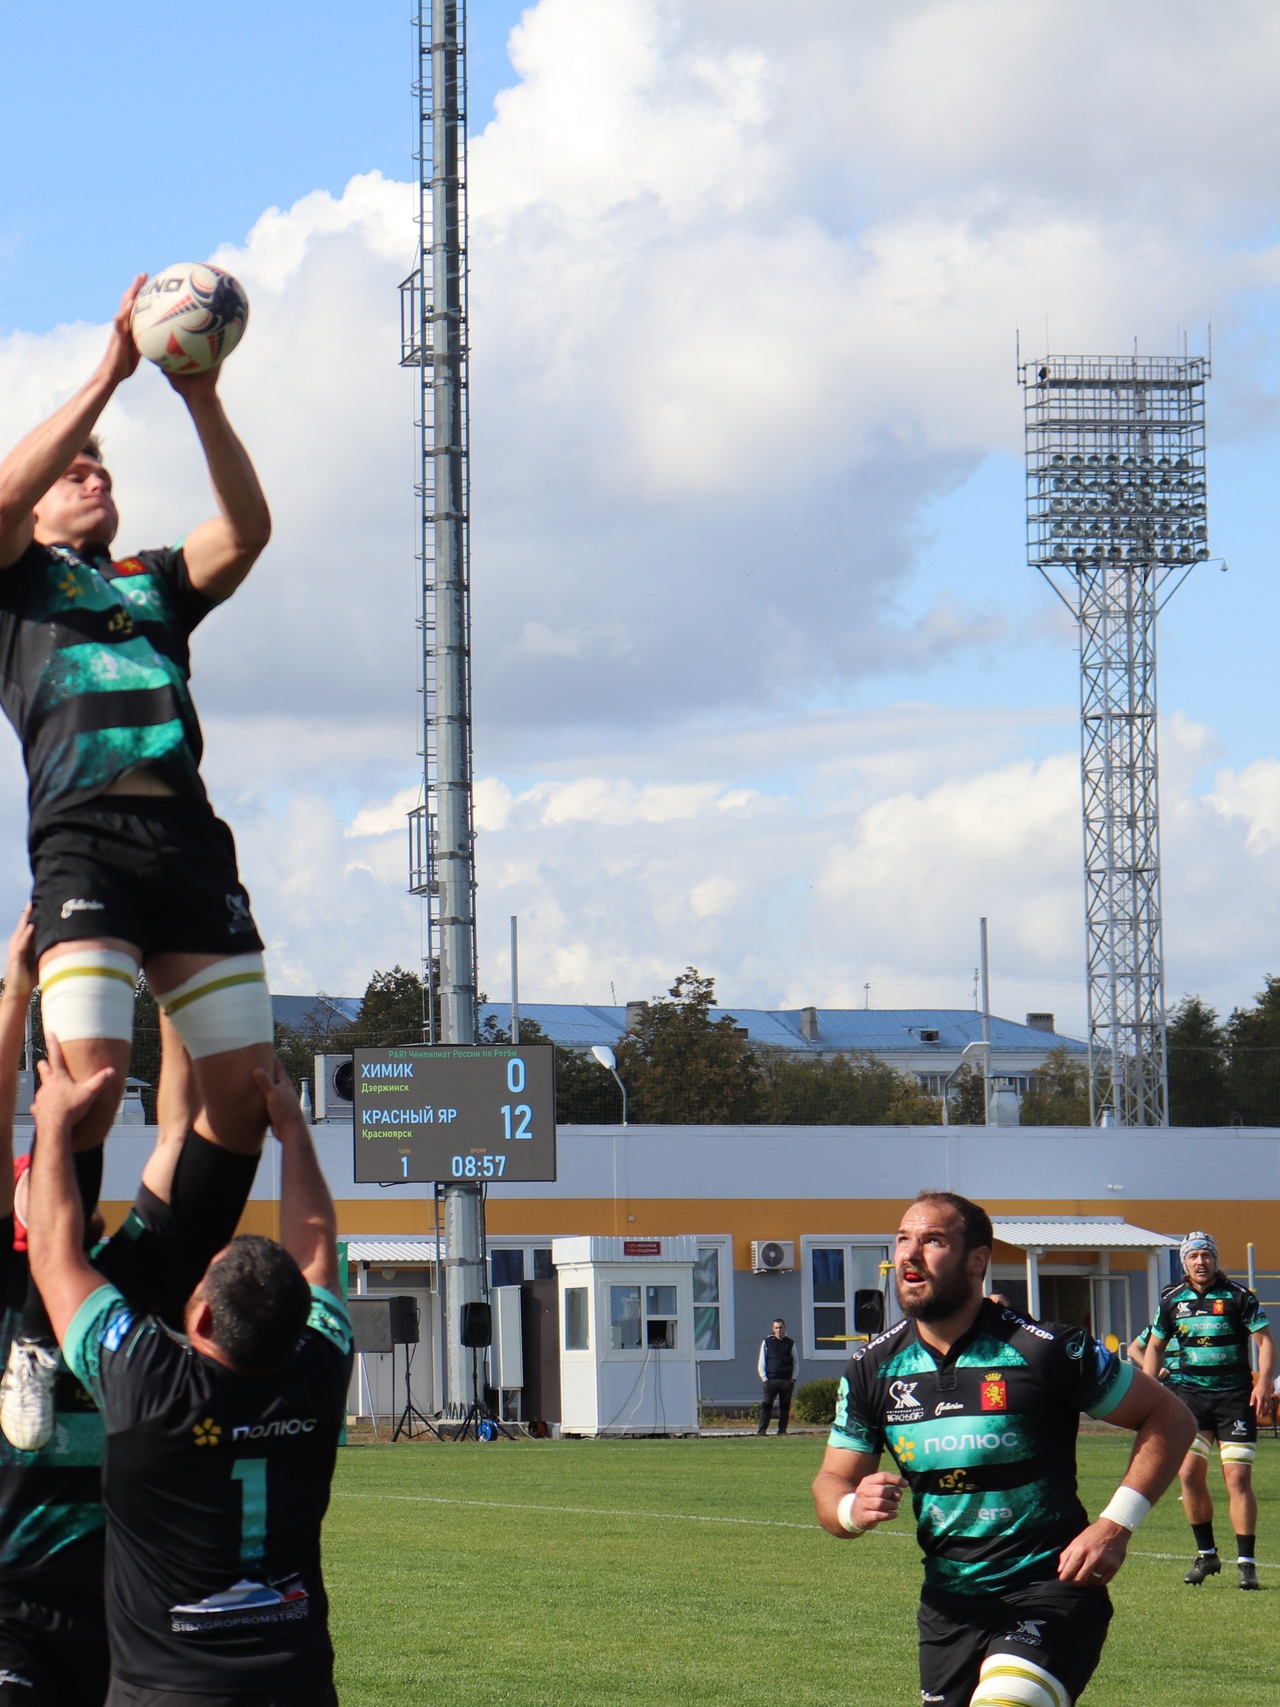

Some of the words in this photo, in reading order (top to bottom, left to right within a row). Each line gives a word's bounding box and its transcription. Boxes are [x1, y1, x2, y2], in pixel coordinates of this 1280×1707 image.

[388, 1051, 407, 1059] PARI
[409, 1051, 451, 1059] Чемпионат
[453, 1050, 481, 1058] России
[495, 1049, 517, 1058] Регби
[361, 1063, 414, 1078] ХИМИК
[506, 1058, 526, 1093] 0
[361, 1082, 410, 1094] Дзержинск
[362, 1105, 434, 1125] КРАСНЫЙ
[438, 1108, 458, 1123] ЯР
[500, 1104, 533, 1140] 12
[362, 1129, 413, 1140] Красноярск
[401, 1156, 408, 1178] 1
[451, 1155, 506, 1177] 08:57
[232, 1419, 318, 1441] ПОЛЮС
[924, 1432, 1018, 1454] ПОЛЮС
[230, 1458, 268, 1570] 1
[171, 1608, 310, 1633] SIBAGROPROMSTROY
